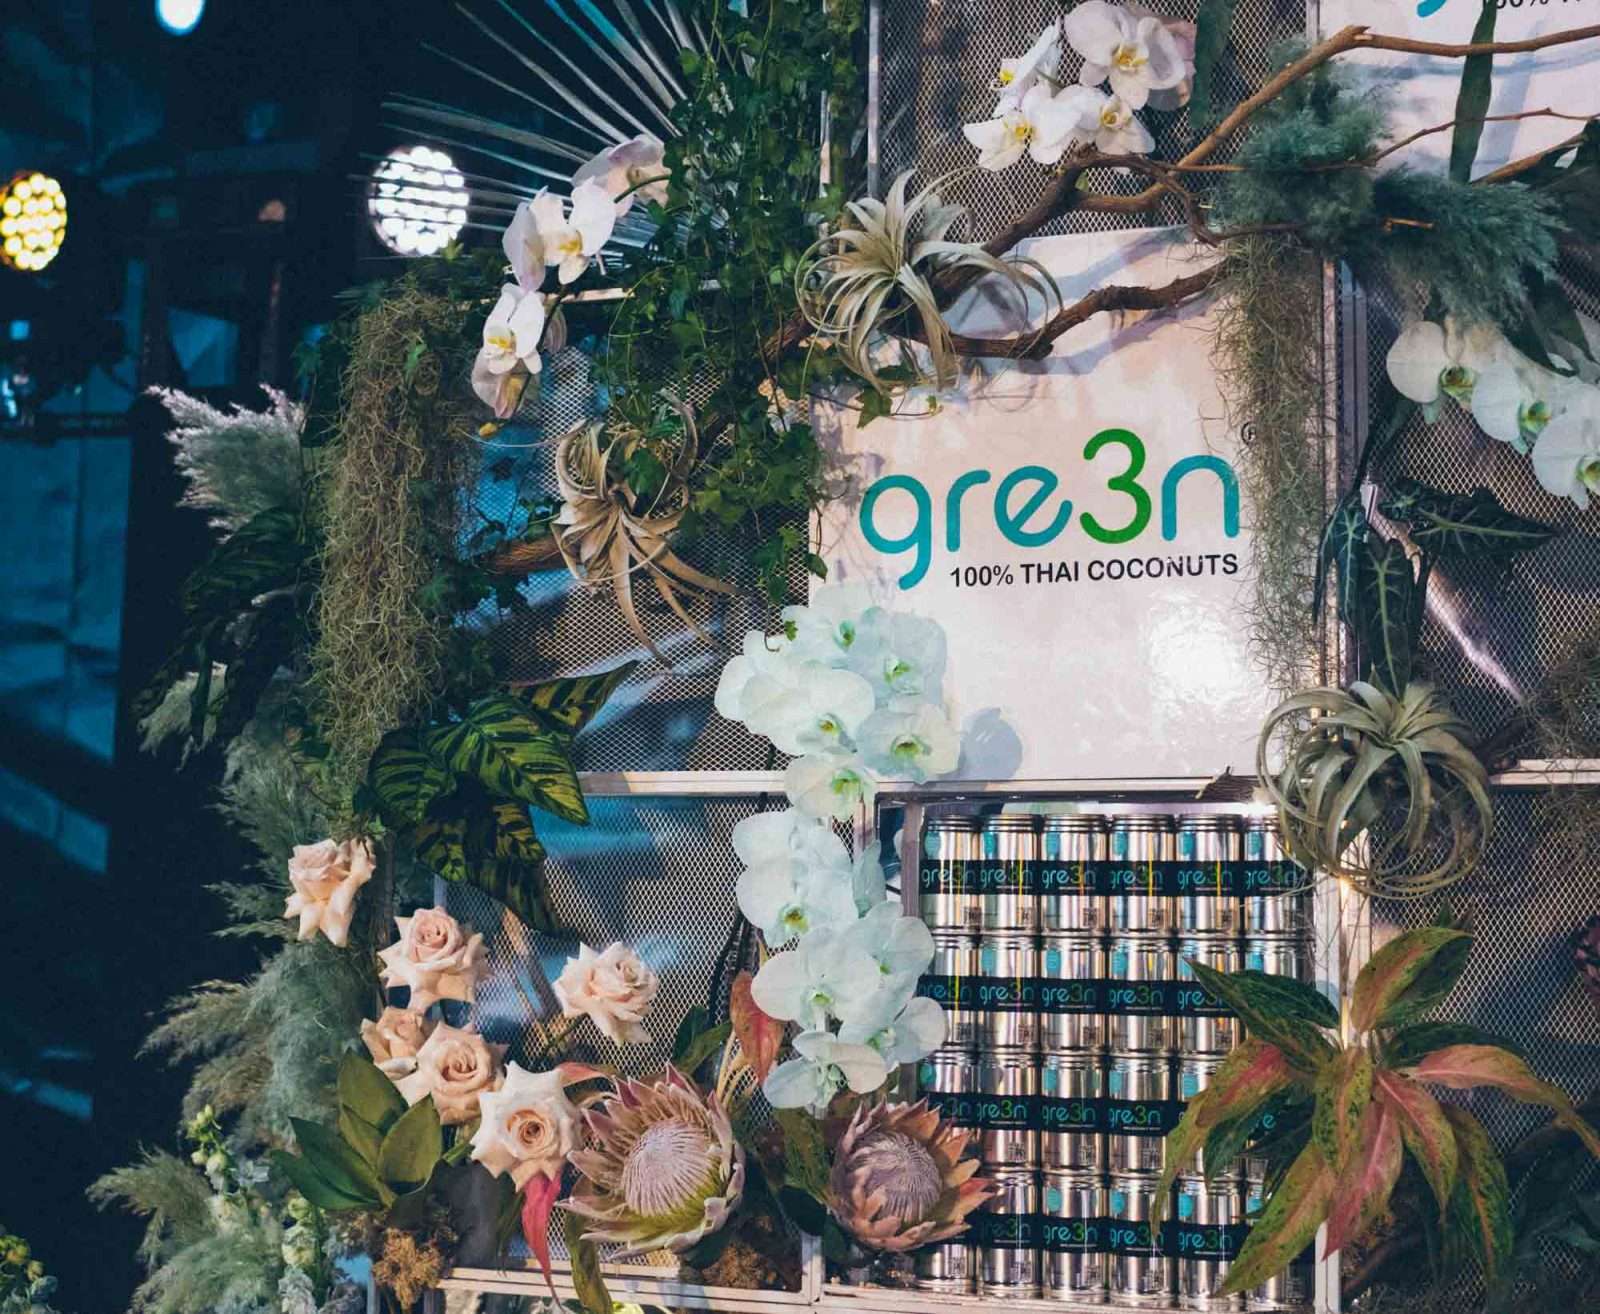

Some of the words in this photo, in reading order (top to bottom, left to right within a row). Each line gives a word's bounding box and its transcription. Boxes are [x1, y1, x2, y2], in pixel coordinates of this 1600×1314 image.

[859, 428, 1240, 590] gre3n
[949, 564, 1015, 588] 100%
[1020, 561, 1080, 585] THAI
[1087, 553, 1239, 582] COCONUTS
[1041, 864, 1096, 890] gre3n
[1041, 983, 1096, 1008] gre3n
[1110, 985, 1164, 1009] gre3n
[976, 1099, 1027, 1122] gre3n
[1041, 1102, 1096, 1126] gre3n
[1109, 1104, 1161, 1128] gre3n
[1043, 1222, 1098, 1245] gre3n
